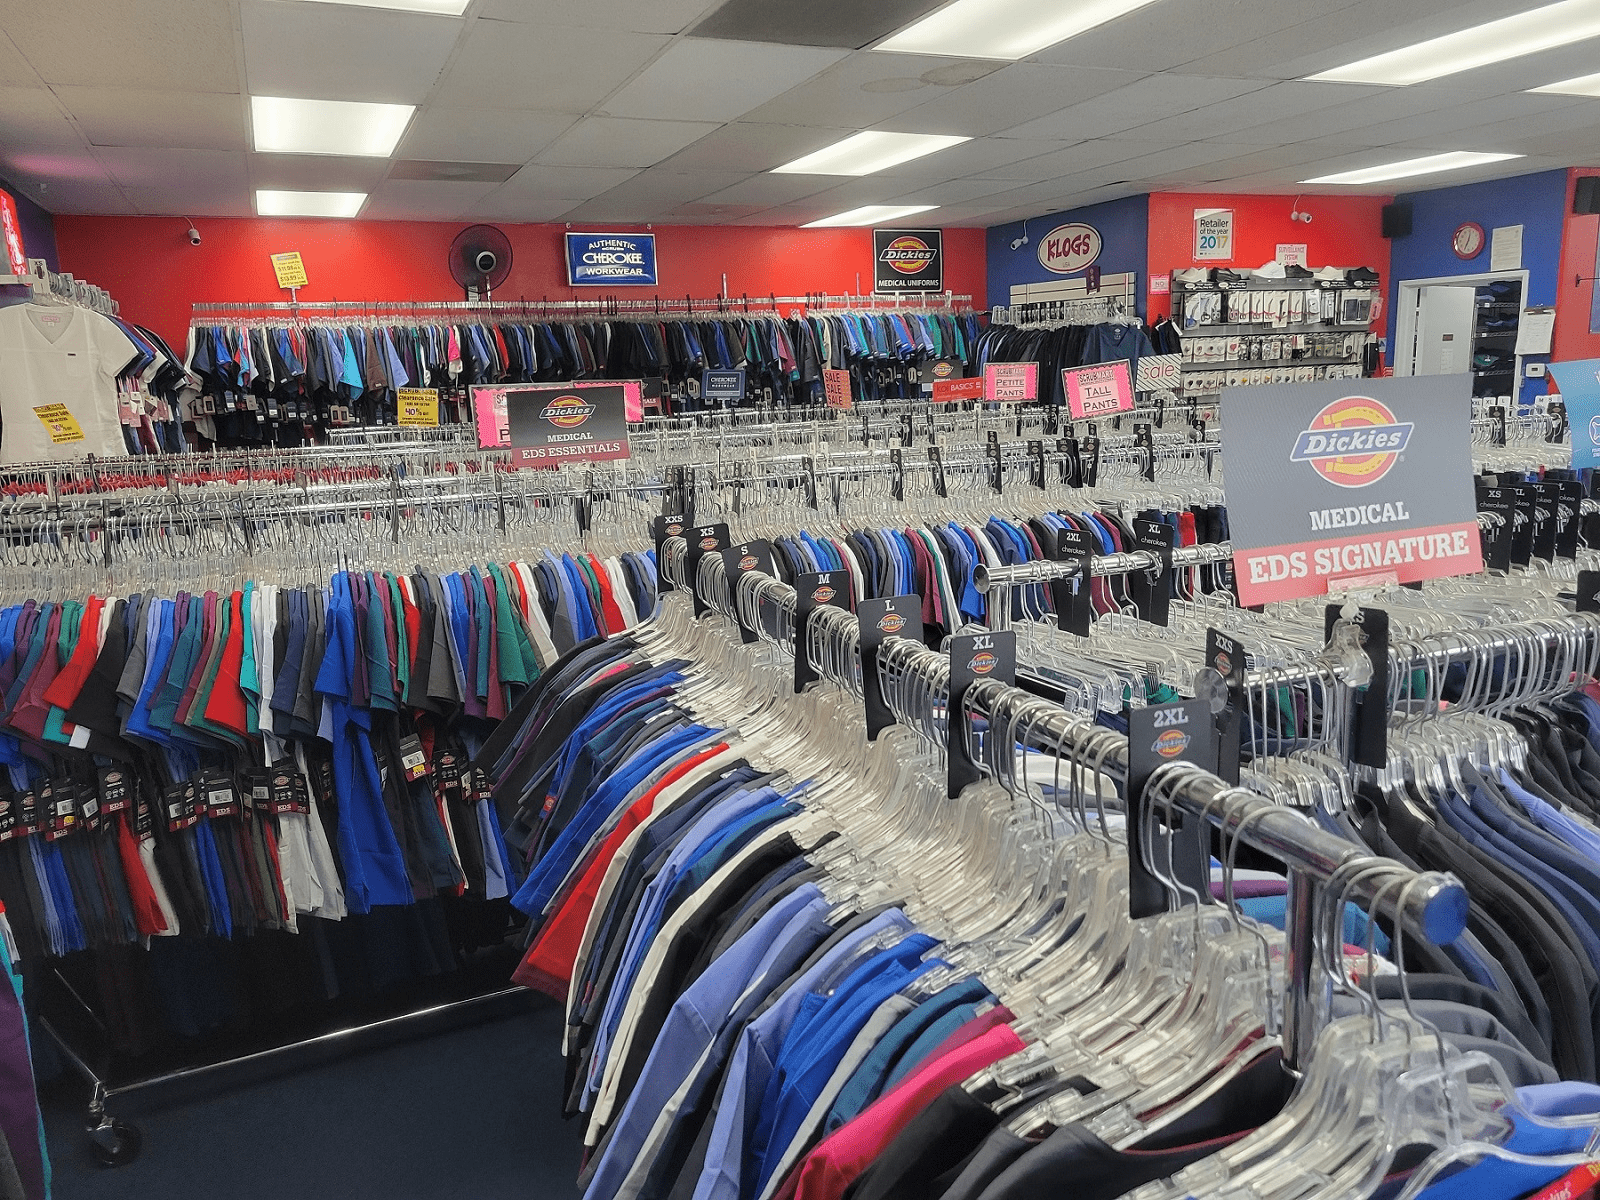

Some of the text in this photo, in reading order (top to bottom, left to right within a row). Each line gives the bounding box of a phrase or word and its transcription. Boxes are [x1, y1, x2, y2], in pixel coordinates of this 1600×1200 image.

[1200, 218, 1229, 228] Retailer
[588, 239, 636, 251] AUTHENTIC
[1047, 233, 1091, 262] KLOGS
[1199, 235, 1228, 249] 2017
[582, 252, 645, 265] CHEROKEE
[885, 250, 932, 260] Dickies
[586, 267, 643, 276] WORKWEAR
[878, 279, 939, 287] MEDICAL UNIFORMS
[1142, 361, 1175, 381] sale
[825, 372, 841, 383] SALE
[995, 378, 1025, 387] PETITE
[827, 383, 842, 394] SALE
[950, 382, 974, 391] BASICS
[1084, 386, 1112, 397] TALL
[995, 389, 1024, 397] PANTS
[828, 394, 843, 406] SALE
[1083, 398, 1118, 412] PANTS
[545, 406, 592, 417] Dickies
[547, 432, 594, 443] MEDICAL
[1302, 428, 1402, 455] Dickies
[521, 442, 621, 460] EDS ESSENTIALS
[1487, 489, 1502, 498] XS
[1559, 494, 1576, 502] okee
[1479, 501, 1509, 510] cherokee
[1536, 496, 1553, 504] okee
[664, 515, 684, 524] XXS
[1308, 501, 1410, 531] MEDICAL
[699, 526, 715, 537] XS
[1148, 523, 1161, 534] XL
[1066, 532, 1082, 543] 2XL
[1140, 535, 1168, 548] cherokee
[740, 545, 749, 555] S
[1061, 545, 1086, 556] cherokee
[1248, 551, 1309, 585] EDS
[1314, 530, 1471, 575] SIGNATURE
[818, 573, 831, 585] M
[884, 599, 895, 612] L
[972, 634, 995, 651] XL
[1215, 632, 1233, 655] XXS
[1153, 706, 1190, 729] 2XL
[109, 801, 124, 812] EDS
[215, 807, 231, 817] EDS
[277, 803, 292, 813] EDS
[53, 828, 68, 839] EDS
